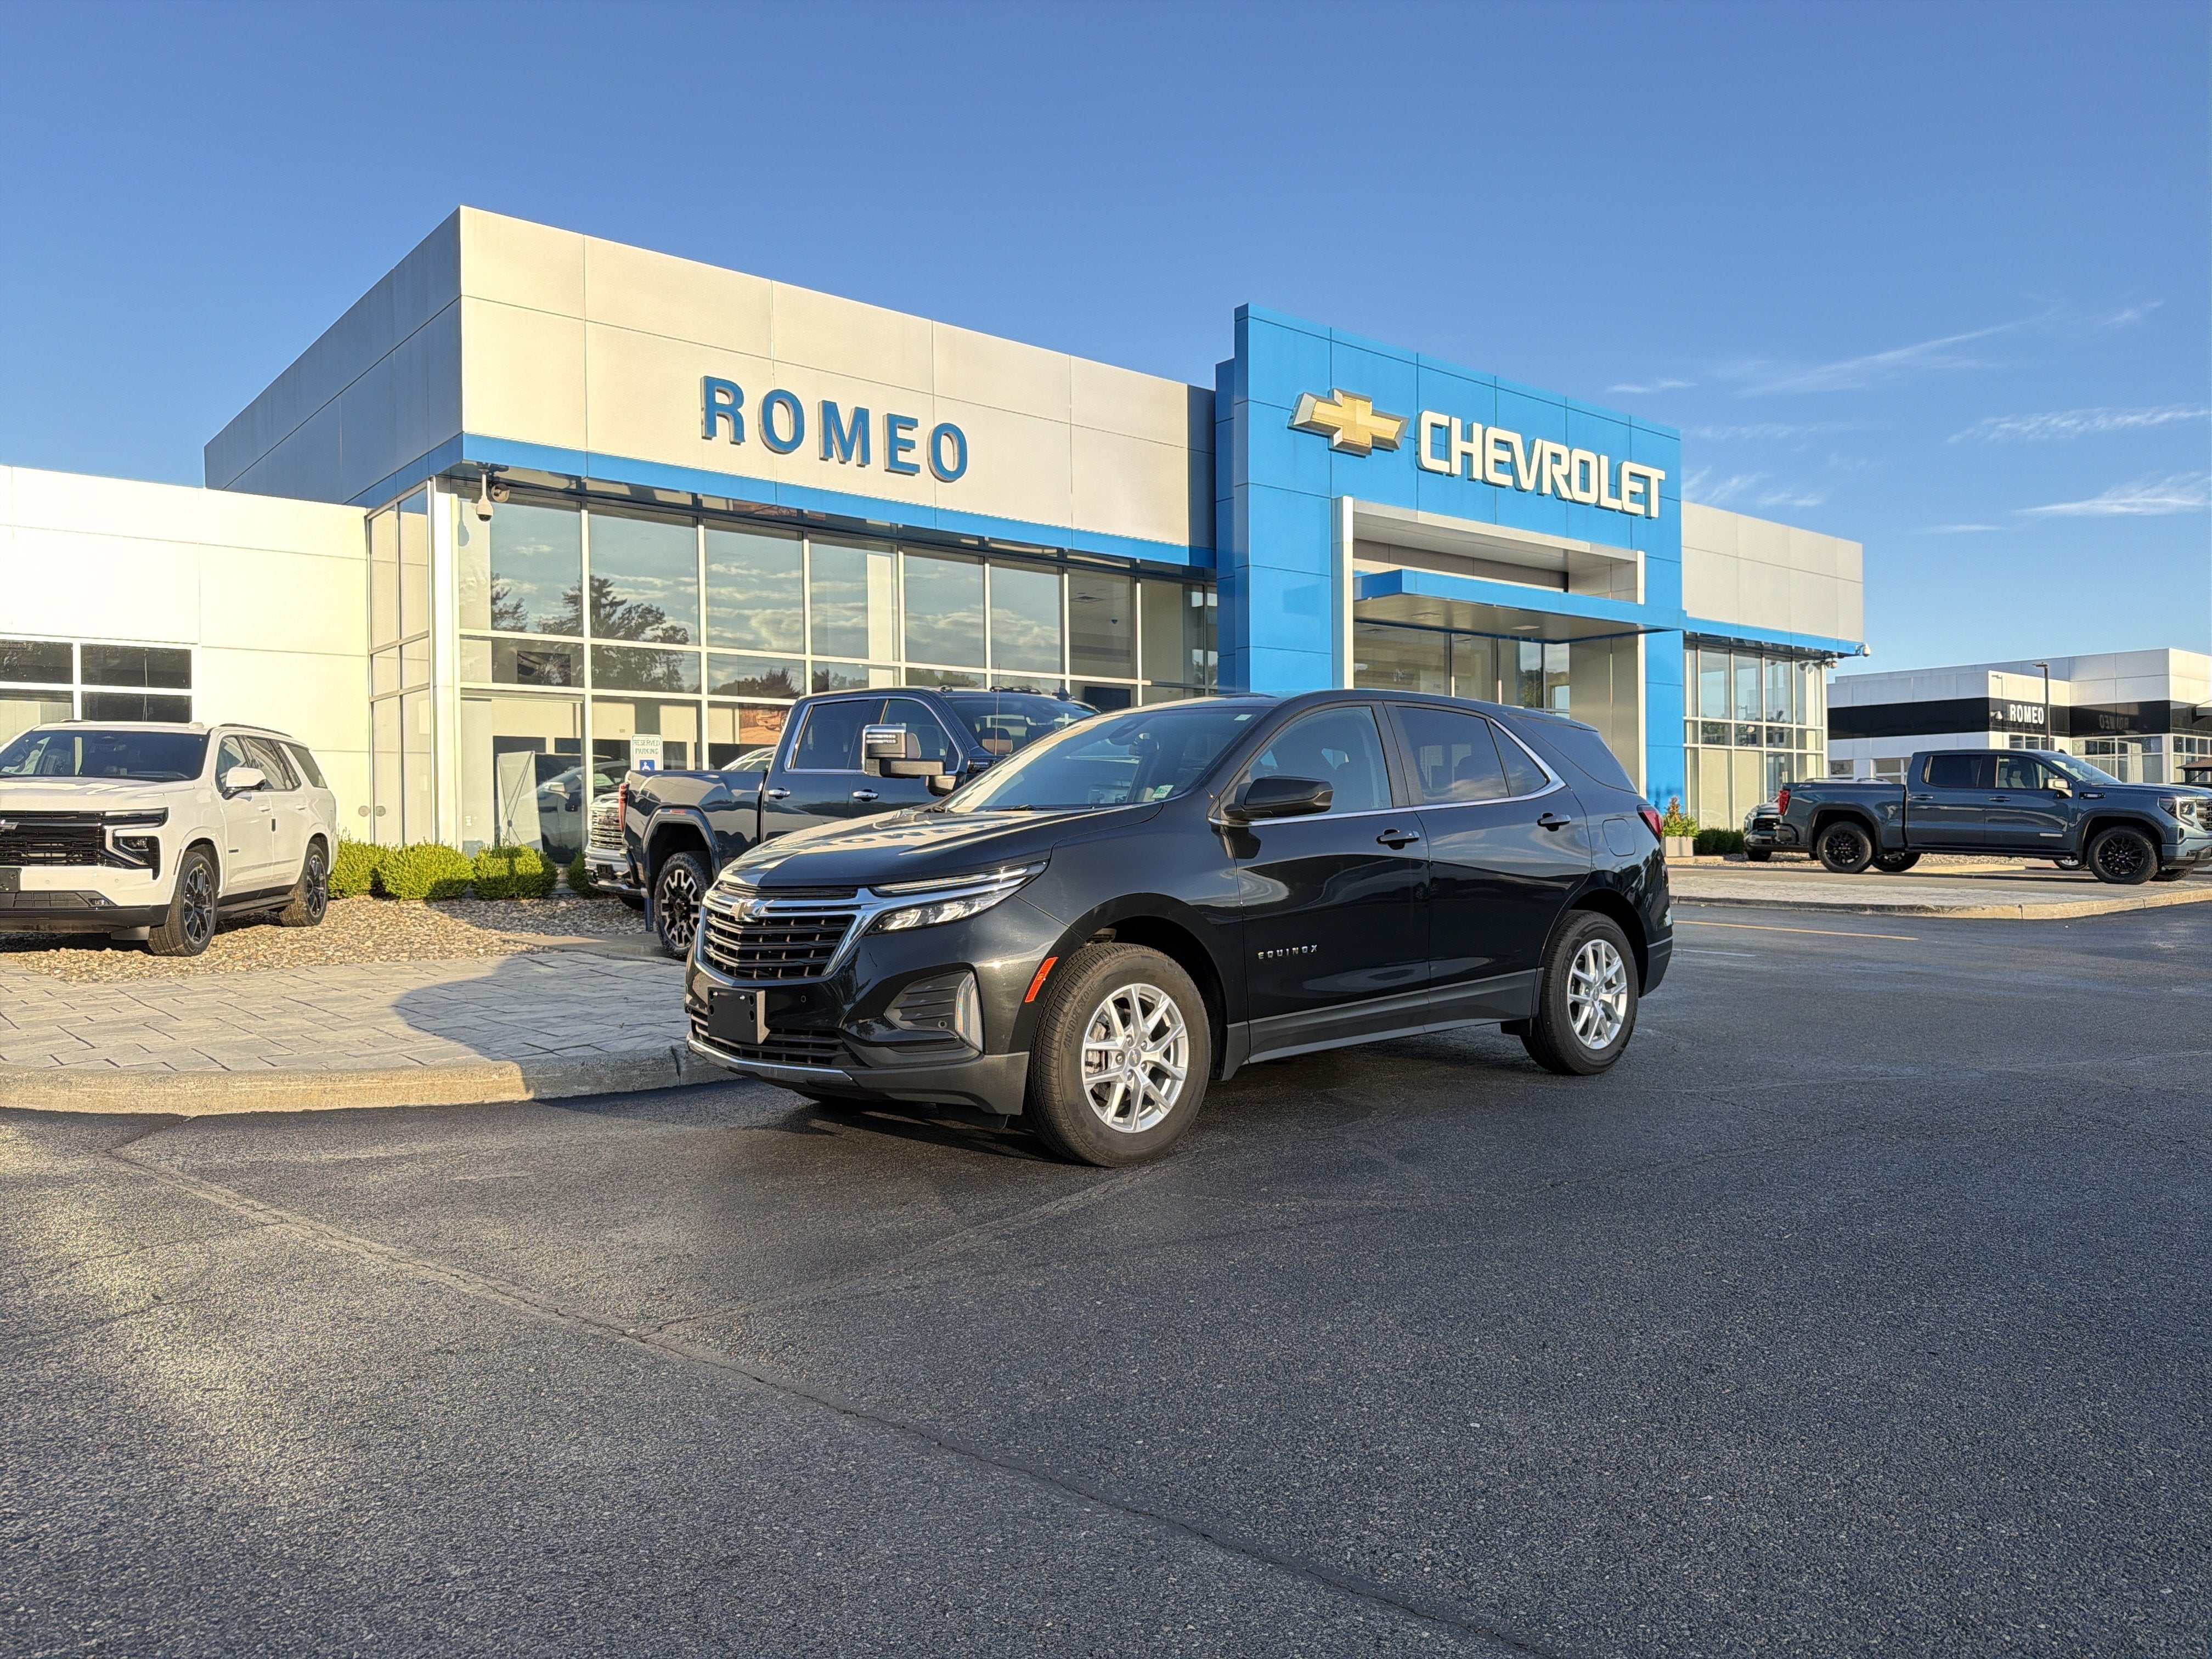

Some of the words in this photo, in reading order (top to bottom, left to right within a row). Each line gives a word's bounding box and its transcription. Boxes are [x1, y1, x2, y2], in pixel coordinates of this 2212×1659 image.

[701, 376, 967, 483] ROMEO
[1417, 410, 1666, 518] CHEVROLET
[2010, 704, 2044, 724] ROMEO
[1258, 945, 1317, 959] EQUINOX
